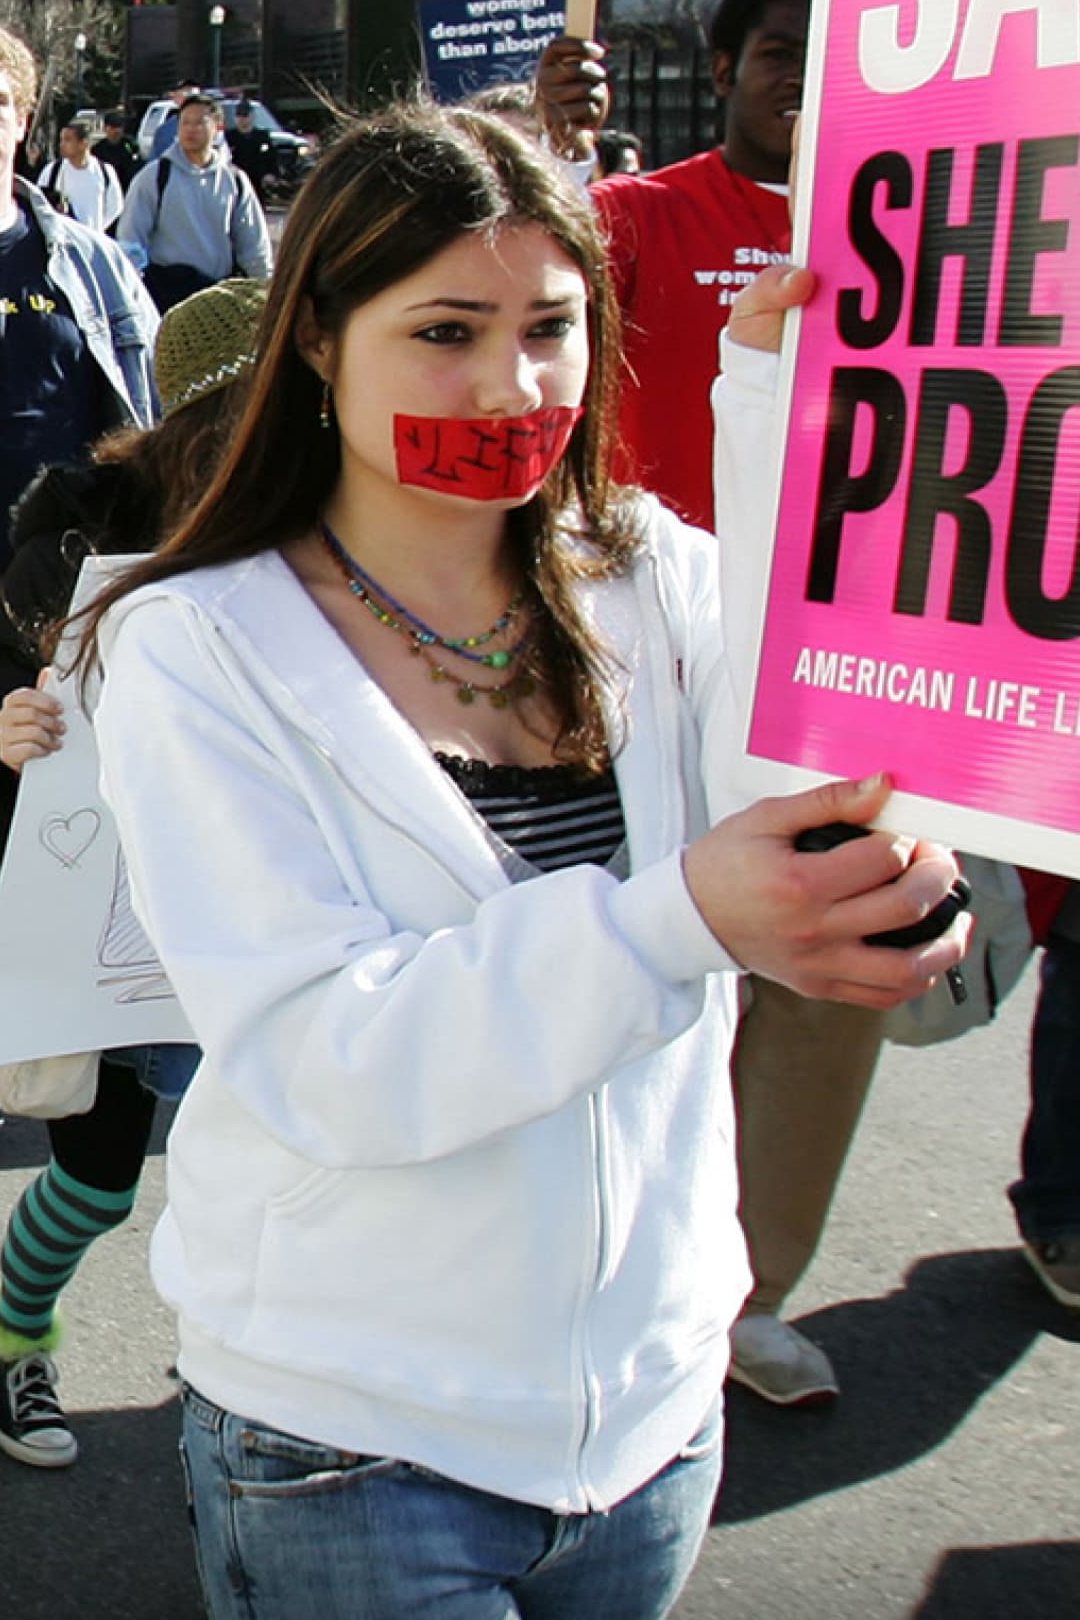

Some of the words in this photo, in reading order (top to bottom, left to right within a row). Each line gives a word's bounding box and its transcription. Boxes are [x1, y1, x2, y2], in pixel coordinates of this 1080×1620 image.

[430, 19, 518, 40] deserve
[438, 41, 488, 61] than
[835, 135, 1080, 350] SHE
[792, 647, 956, 712] AMERICAN
[964, 676, 1041, 728] LIFE
